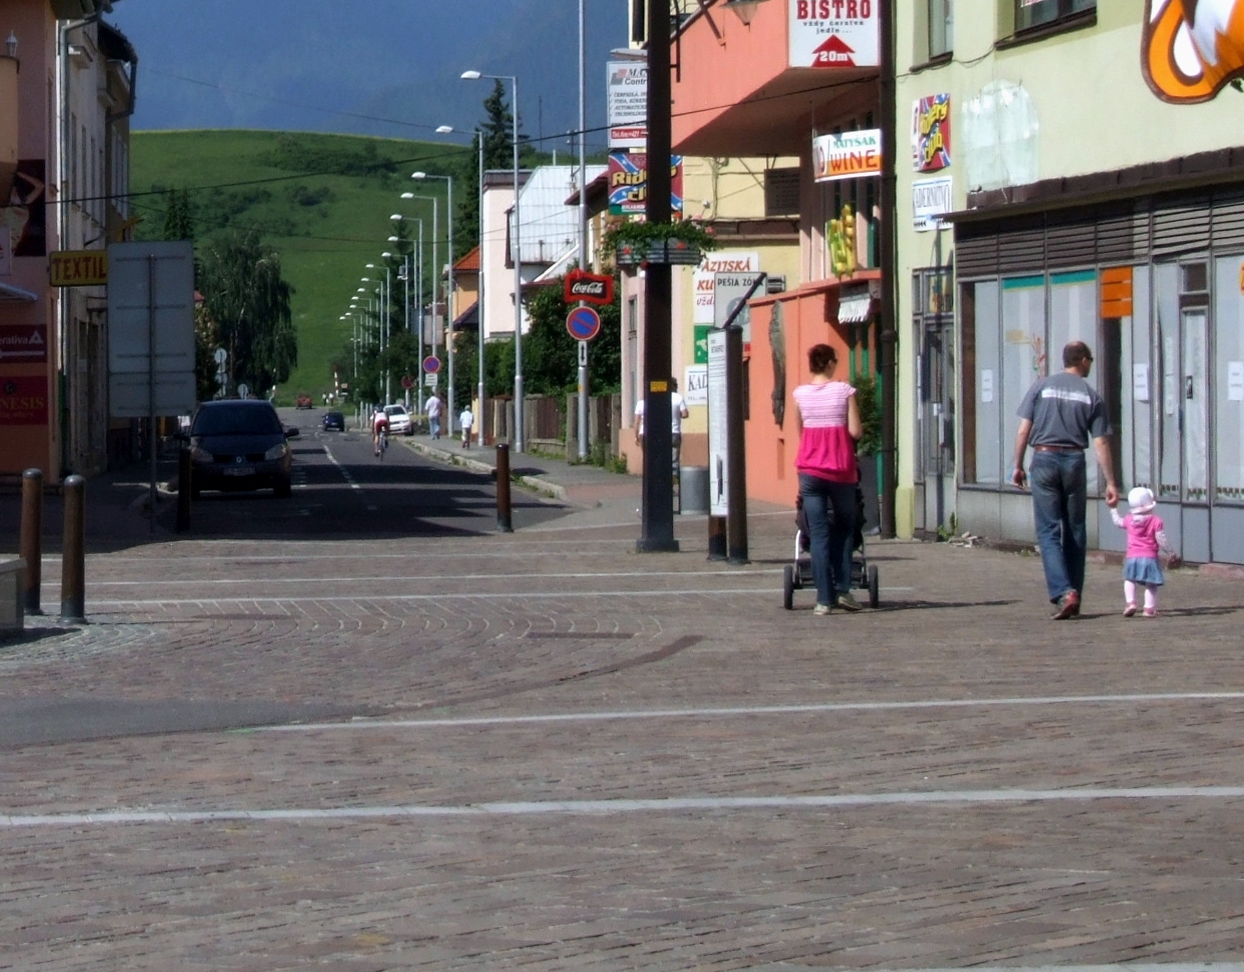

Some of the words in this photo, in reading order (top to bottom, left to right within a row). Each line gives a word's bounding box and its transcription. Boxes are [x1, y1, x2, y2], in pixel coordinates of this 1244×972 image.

[819, 50, 849, 62] 20m
[830, 149, 878, 171] WINE
[53, 257, 107, 280] TEXTIL
[572, 282, 604, 294] Coca-Cola
[696, 279, 714, 290] KU
[696, 295, 714, 306] vžd
[688, 374, 708, 391] KAD
